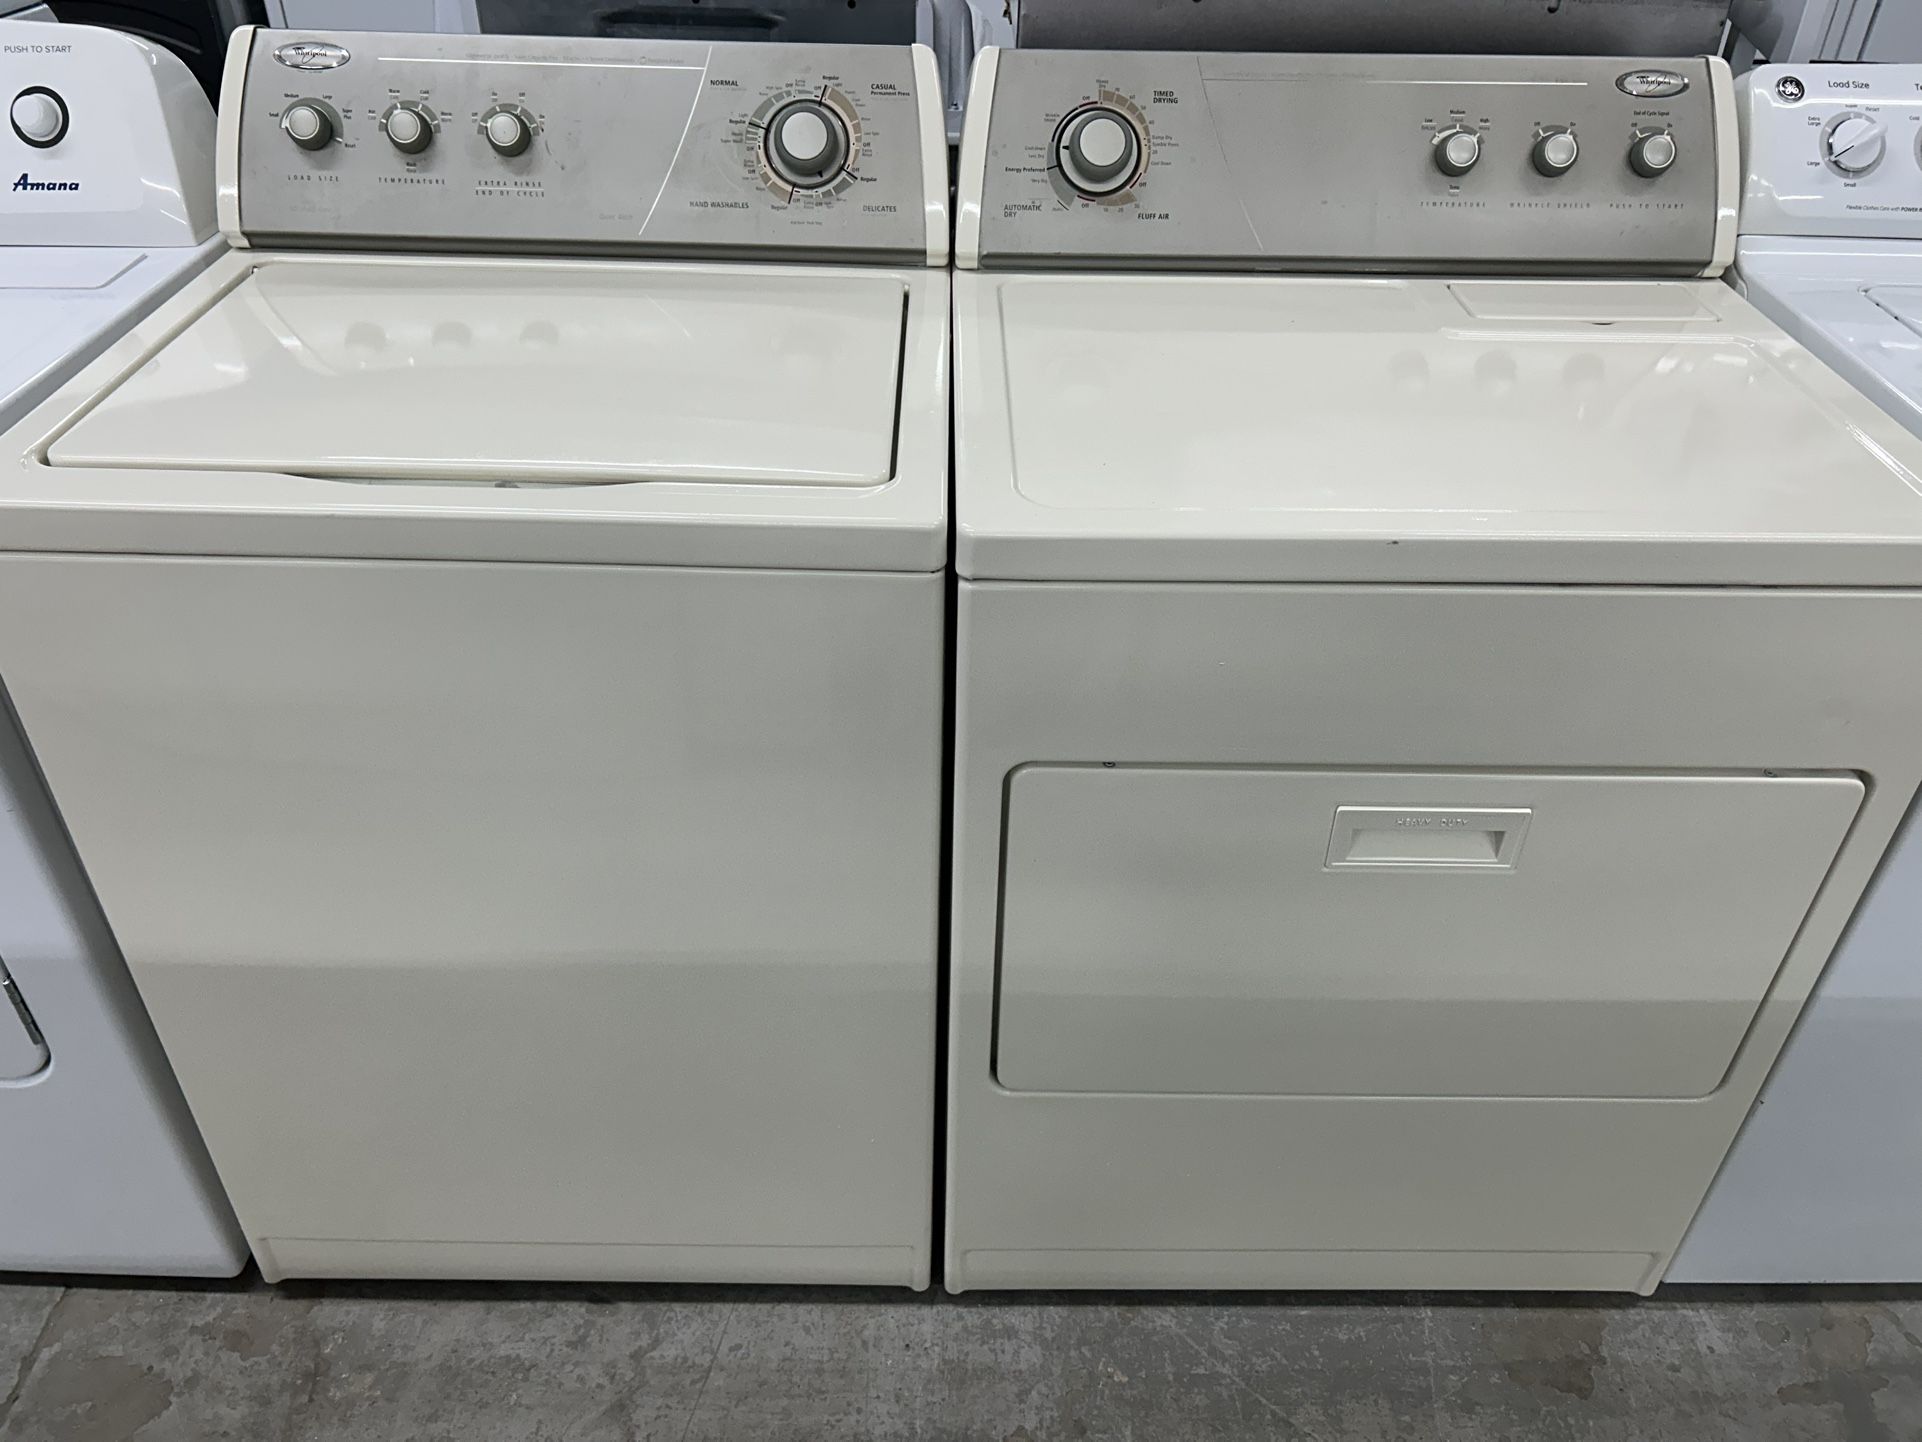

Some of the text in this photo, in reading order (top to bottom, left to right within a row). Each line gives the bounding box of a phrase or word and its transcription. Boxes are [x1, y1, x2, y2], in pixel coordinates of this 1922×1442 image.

[4, 45, 72, 53] PUSH TO START
[292, 46, 327, 60] Whirlpool
[710, 79, 739, 87] NORMAL
[871, 83, 897, 91] CASUAL
[1636, 75, 1671, 91] Whirlpool
[1828, 80, 1870, 89] Load Size
[12, 173, 80, 192] Amana
[710, 201, 749, 209] WASHABLES
[862, 205, 897, 213] DELICATES
[1396, 818, 1431, 826] HEAVY
